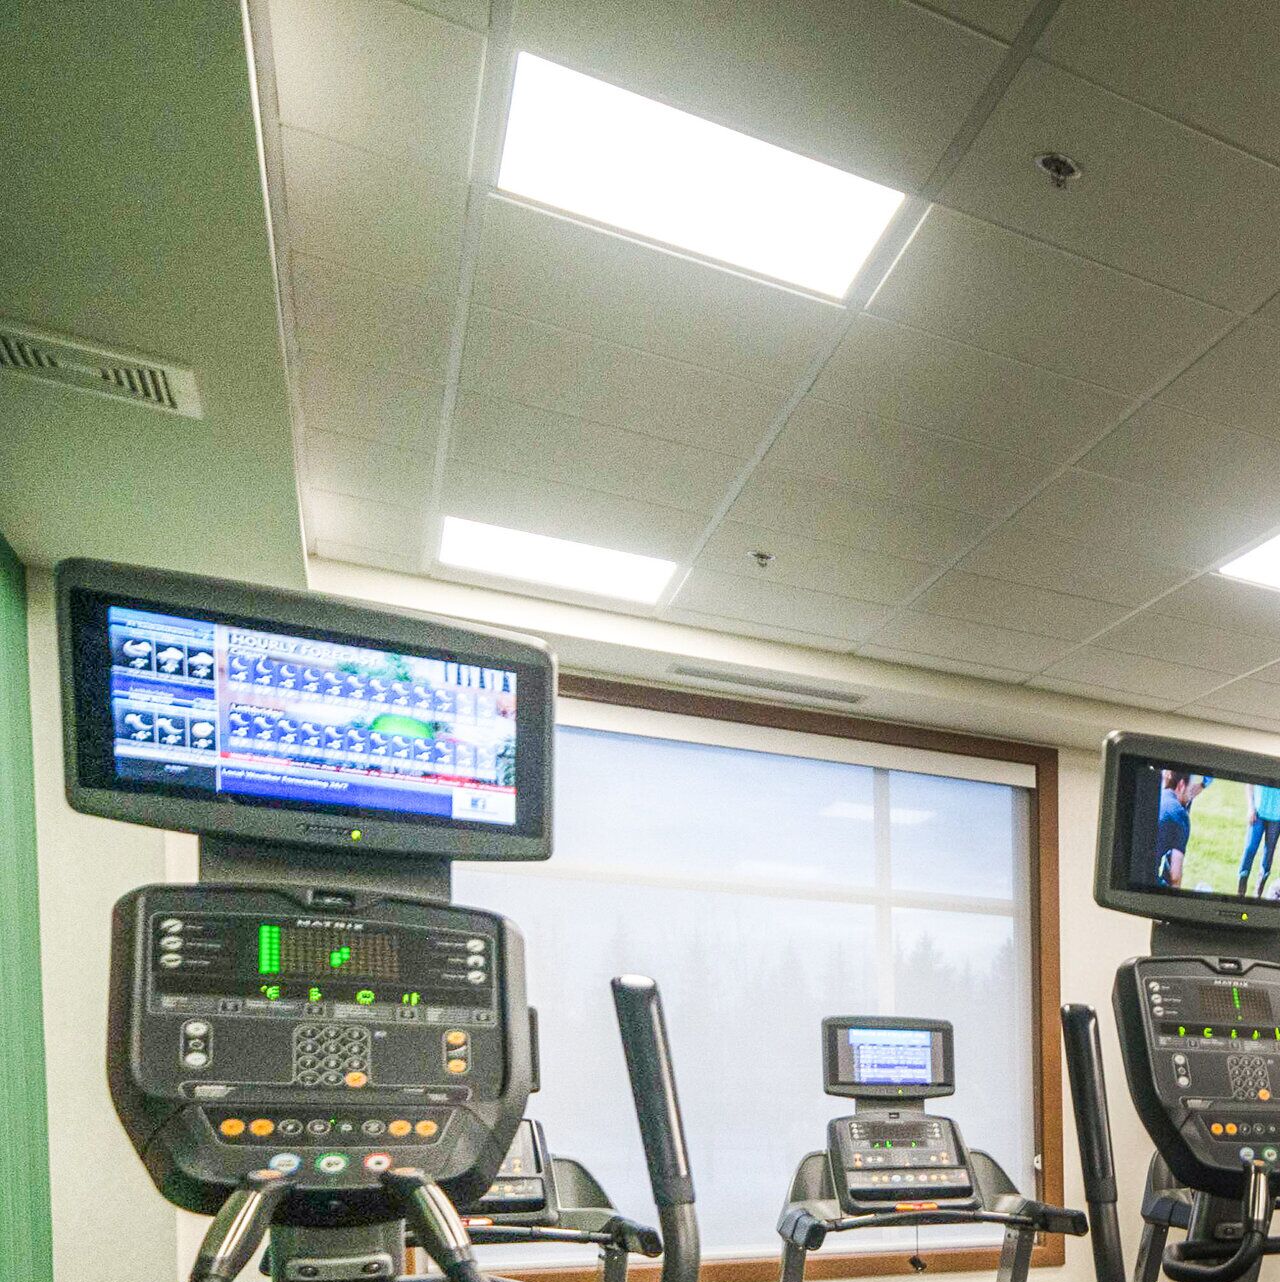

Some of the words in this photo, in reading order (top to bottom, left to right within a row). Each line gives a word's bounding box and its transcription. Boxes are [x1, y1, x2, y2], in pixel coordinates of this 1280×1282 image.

[229, 632, 298, 654] HOURLY
[300, 644, 385, 667] FORECAST
[296, 919, 364, 930] MATRIX
